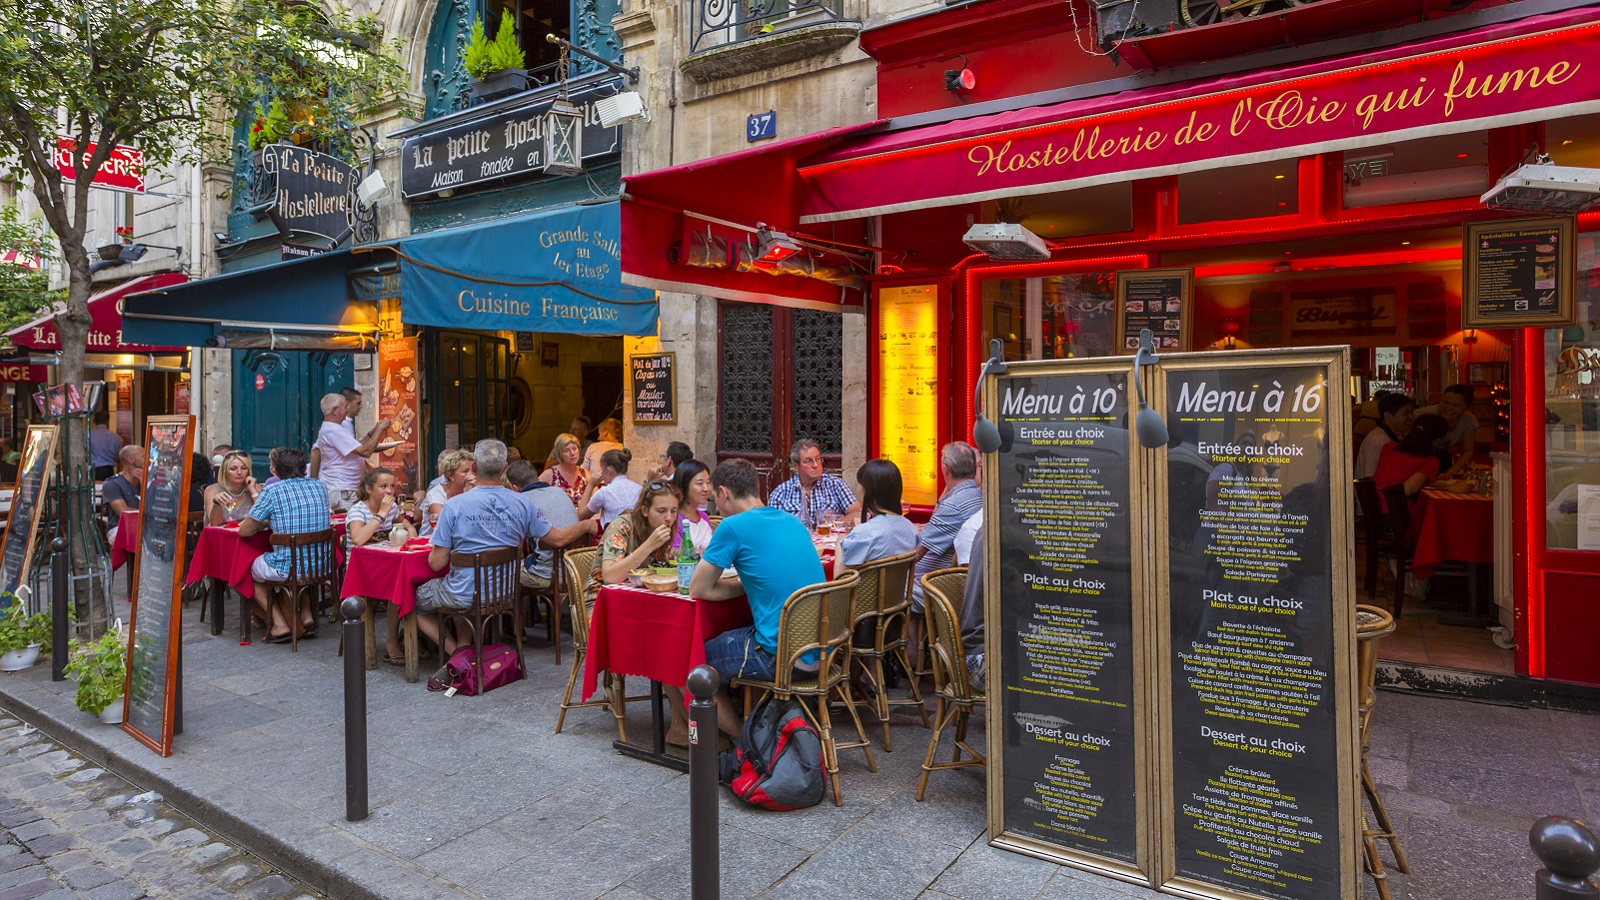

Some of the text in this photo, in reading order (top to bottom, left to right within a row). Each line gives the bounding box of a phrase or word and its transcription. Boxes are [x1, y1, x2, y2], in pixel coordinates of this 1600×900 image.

[750, 115, 771, 137] 37
[967, 126, 1167, 177] Hostellerie
[1174, 111, 1220, 146] de
[1355, 77, 1435, 131] qui
[1444, 60, 1581, 118] fume
[281, 149, 344, 184] La Petite
[412, 143, 433, 169] La
[431, 150, 540, 188] Maison fondée en
[278, 188, 346, 219] Hostellerie
[539, 226, 621, 261] Grande Salle
[576, 247, 591, 259] au
[575, 261, 609, 280] Etage
[457, 289, 619, 324] Cuisine Française
[32, 327, 56, 344] La
[1001, 387, 1064, 415] Menu
[1068, 385, 1084, 414] à
[1176, 382, 1256, 413] Menu
[1263, 380, 1285, 413] à
[1020, 426, 1104, 438] Entrée au choix
[1197, 441, 1303, 456] Entrée au choix
[1023, 573, 1106, 589] Plat au choix
[1202, 589, 1303, 609] Plat au choix
[1025, 721, 1110, 747] Dessert au choix
[1201, 725, 1305, 753] Dessert au choix
